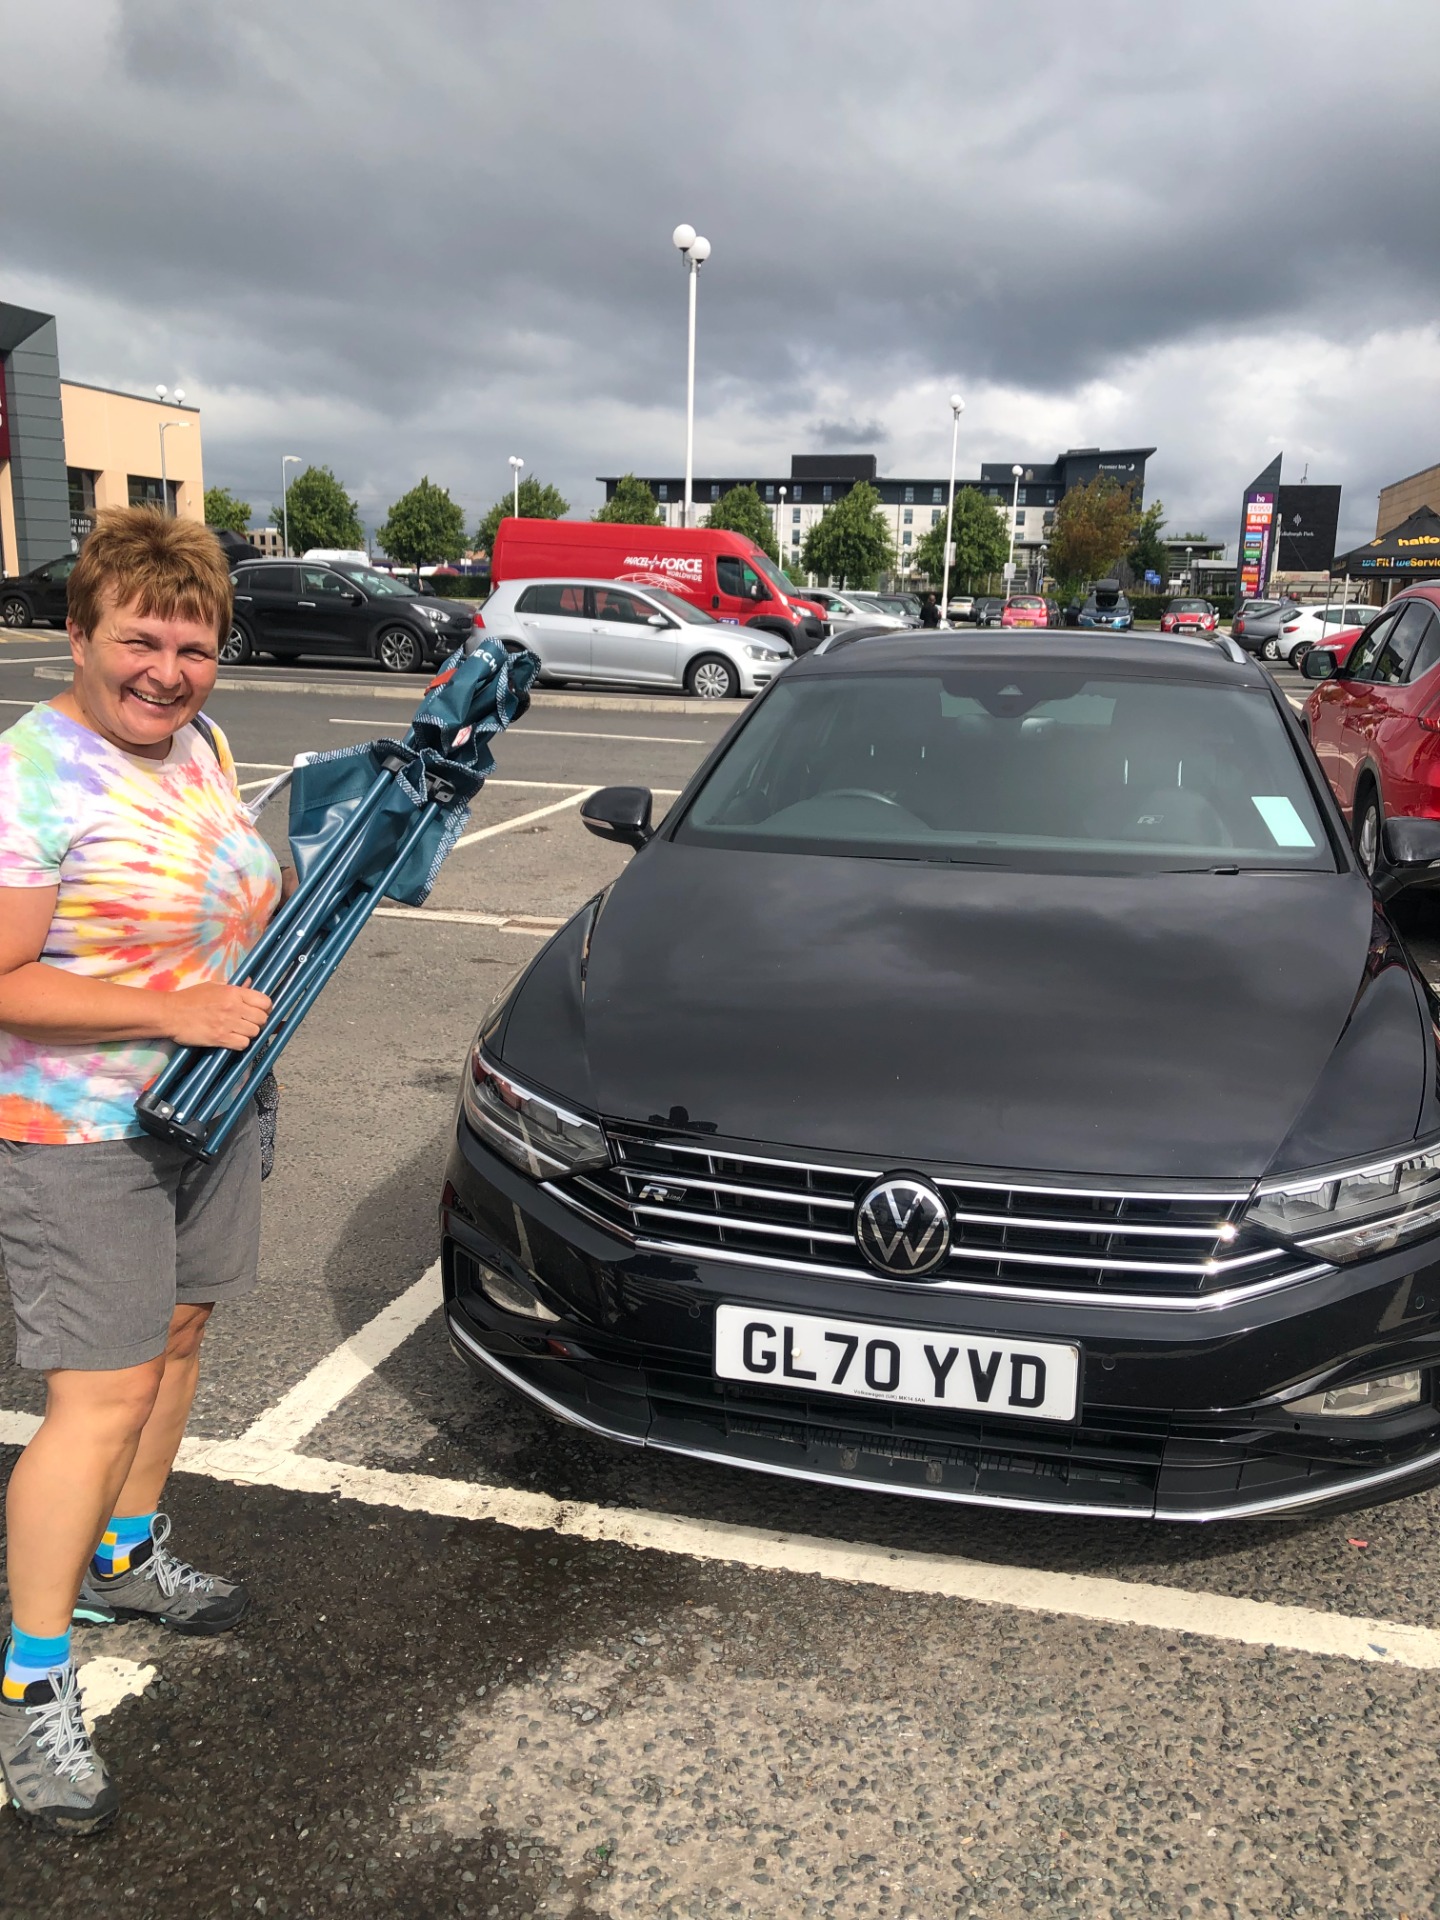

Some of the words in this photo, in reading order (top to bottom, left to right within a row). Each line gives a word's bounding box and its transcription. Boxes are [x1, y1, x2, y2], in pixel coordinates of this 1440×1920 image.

[623, 556, 650, 568] PARCEL
[659, 557, 703, 574] FORCE
[666, 570, 703, 582] WORLDWIDE
[743, 1321, 901, 1393] GL70
[923, 1344, 1047, 1409] YVD
